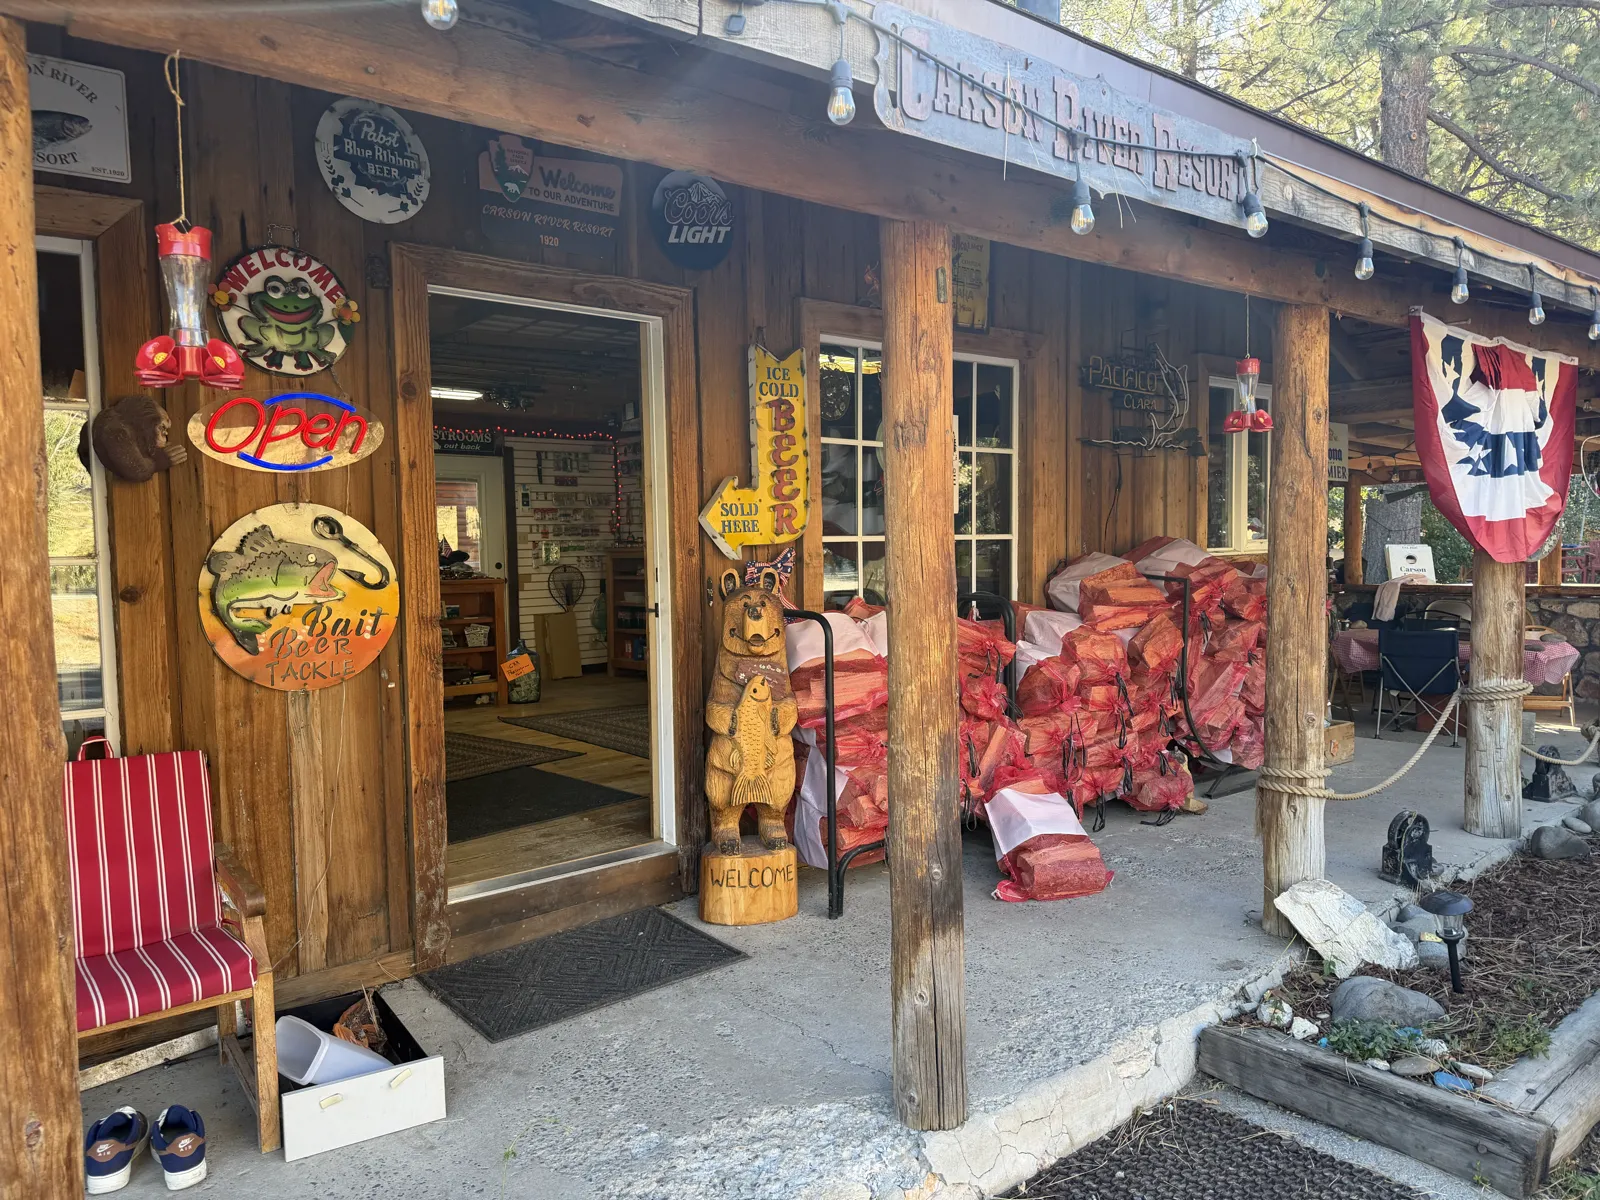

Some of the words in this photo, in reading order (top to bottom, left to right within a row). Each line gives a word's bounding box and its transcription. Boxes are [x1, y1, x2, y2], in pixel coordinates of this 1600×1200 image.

[50, 67, 98, 103] RIVER
[901, 27, 1044, 141] CARSON
[1053, 76, 1144, 176] RIVER
[1153, 113, 1249, 203] RESORT
[358, 118, 400, 148] Pabst
[33, 151, 79, 165] SORT
[344, 138, 373, 159] Blue
[374, 145, 418, 170] Ribbon
[367, 163, 399, 179] BEER
[539, 165, 616, 200] Welcome
[528, 186, 540, 197] TO
[543, 189, 562, 201] OUR
[564, 195, 615, 212] ADVENTURE
[665, 188, 735, 226] Coors
[482, 203, 532, 222] CARSON
[534, 213, 571, 231] RIVER
[572, 221, 616, 239] RESORT
[668, 225, 731, 244] LIGHT
[540, 234, 559, 247] 1920
[223, 249, 345, 305] WELCOME
[766, 366, 791, 381] ICE
[1089, 355, 1157, 392] PACIFICO
[758, 381, 799, 398] COLD
[1123, 393, 1157, 410] CLARA
[206, 397, 368, 460] Open
[767, 398, 800, 535] BEER
[720, 502, 759, 517] SOLD
[721, 519, 760, 534] HERE
[1399, 565, 1427, 573] Carson
[301, 604, 390, 638] Bait
[265, 659, 356, 687] TACKLE
[710, 864, 794, 889] WELCOME
